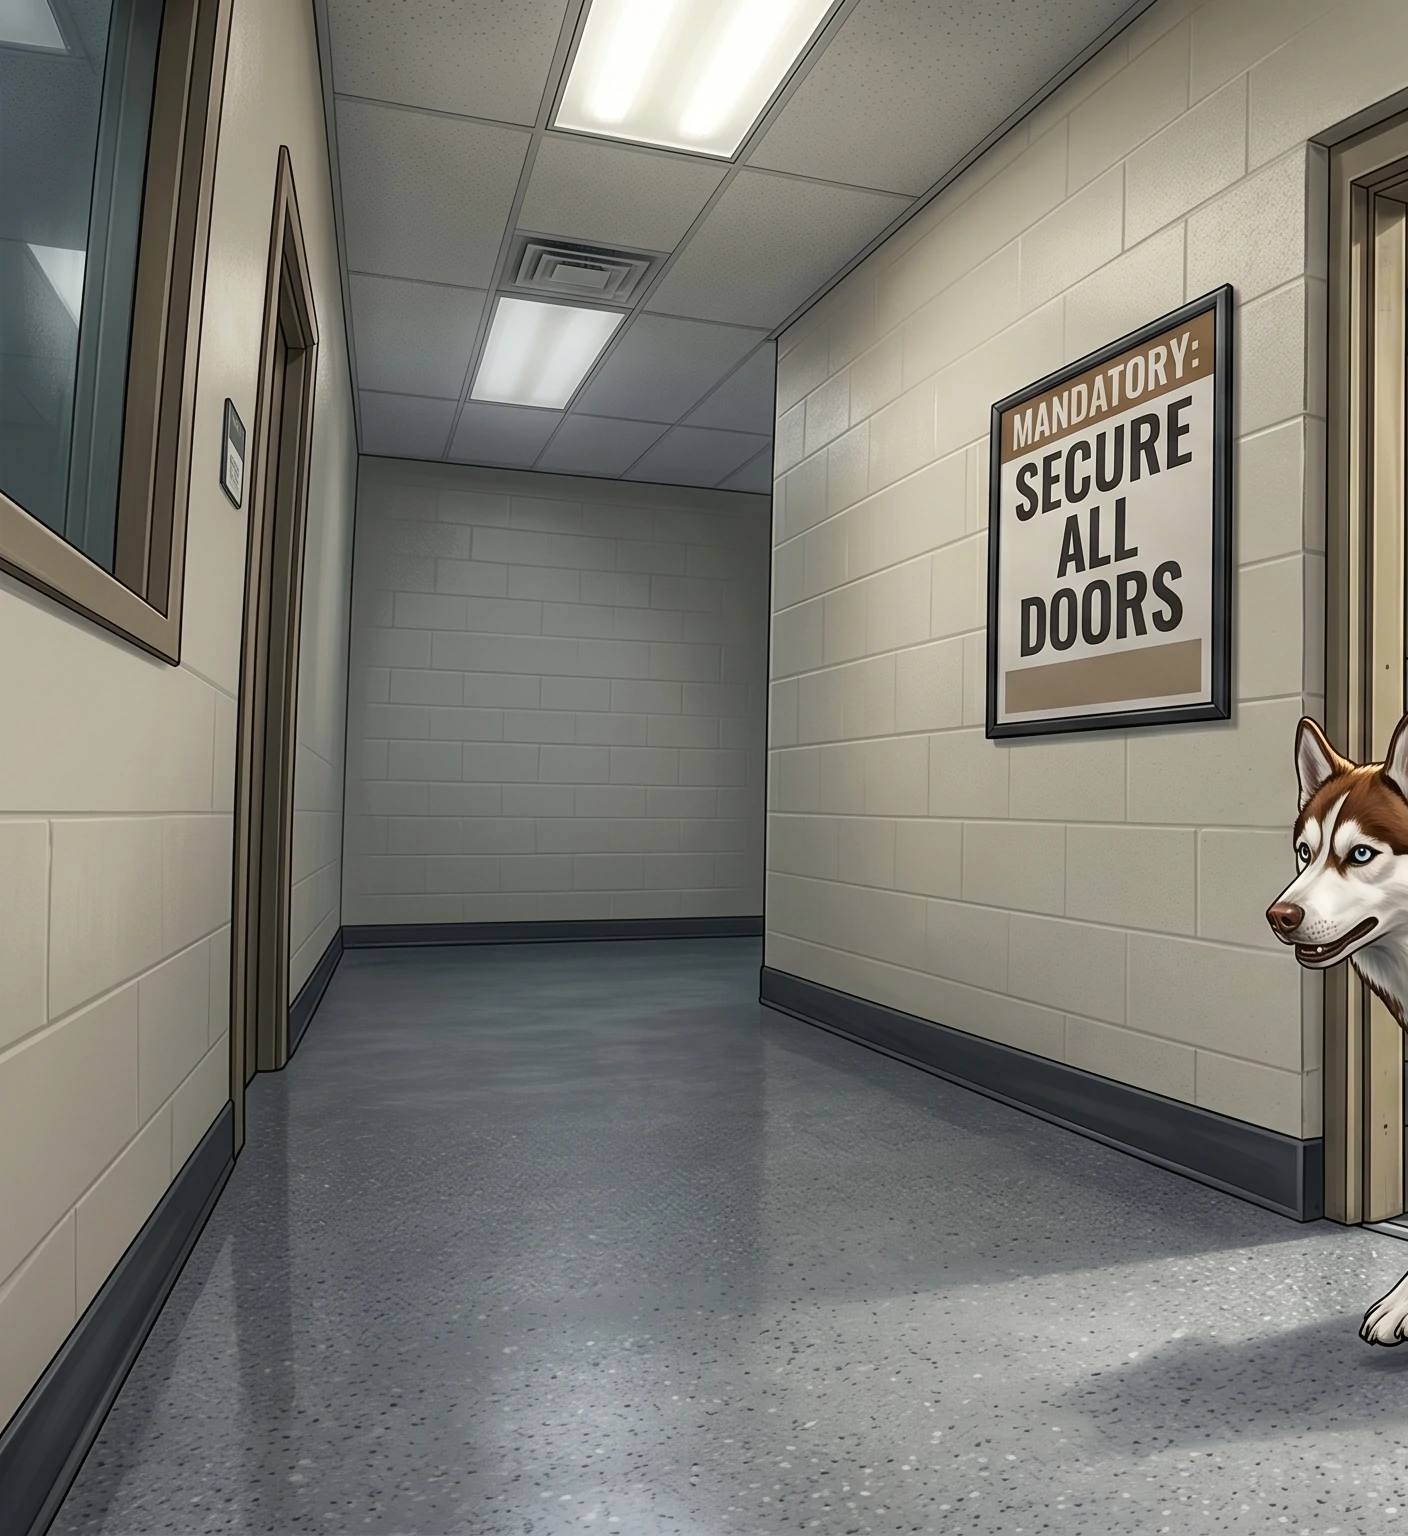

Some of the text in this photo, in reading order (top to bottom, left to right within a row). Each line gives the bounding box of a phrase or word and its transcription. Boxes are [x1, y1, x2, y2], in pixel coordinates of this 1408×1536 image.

[1012, 331, 1200, 453] MANDATORY:
[1015, 395, 1194, 522] SECURE
[1056, 496, 1139, 579] ALL
[1020, 560, 1184, 658] DOORS
